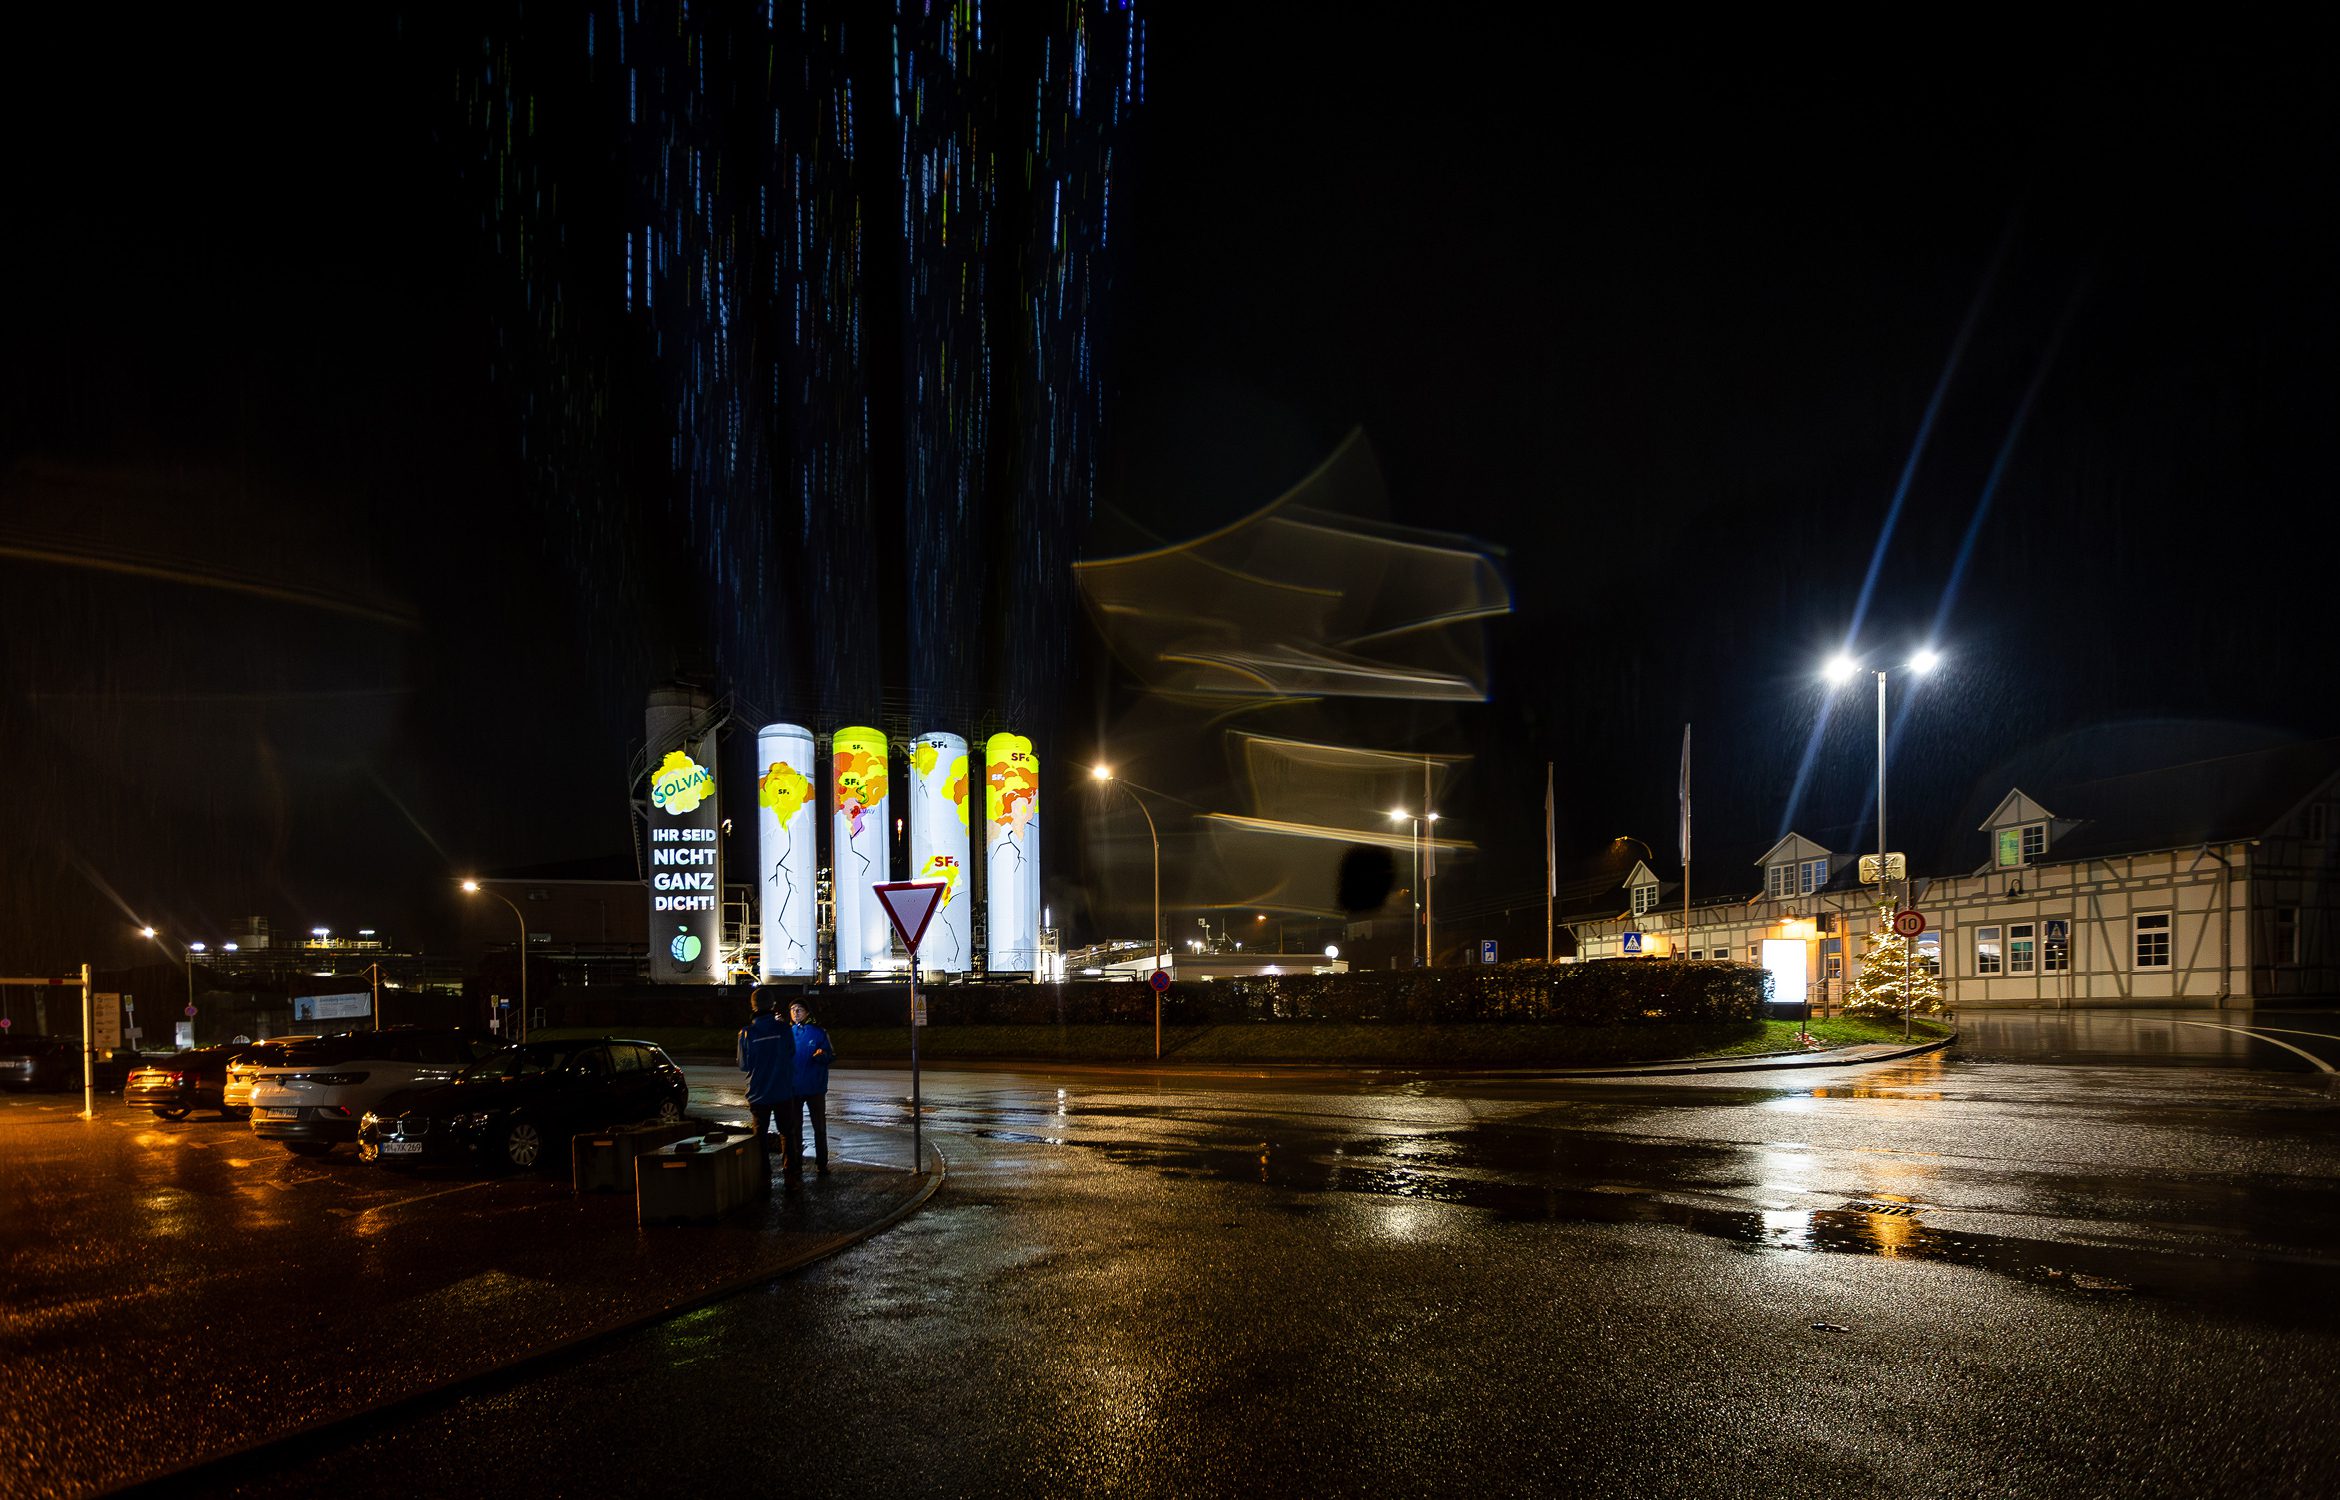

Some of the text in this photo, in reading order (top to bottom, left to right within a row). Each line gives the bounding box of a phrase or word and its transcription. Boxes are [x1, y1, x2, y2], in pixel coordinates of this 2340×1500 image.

[1011, 753, 1030, 762] SF6
[654, 767, 711, 804] SOLVAY
[653, 829, 716, 842] IHR SEID
[653, 848, 717, 865] NICHT
[934, 856, 959, 867] SF6
[654, 872, 715, 890] GANZ
[655, 896, 715, 911] DICHT!
[1901, 918, 1917, 930] 10
[1484, 942, 1491, 951] P
